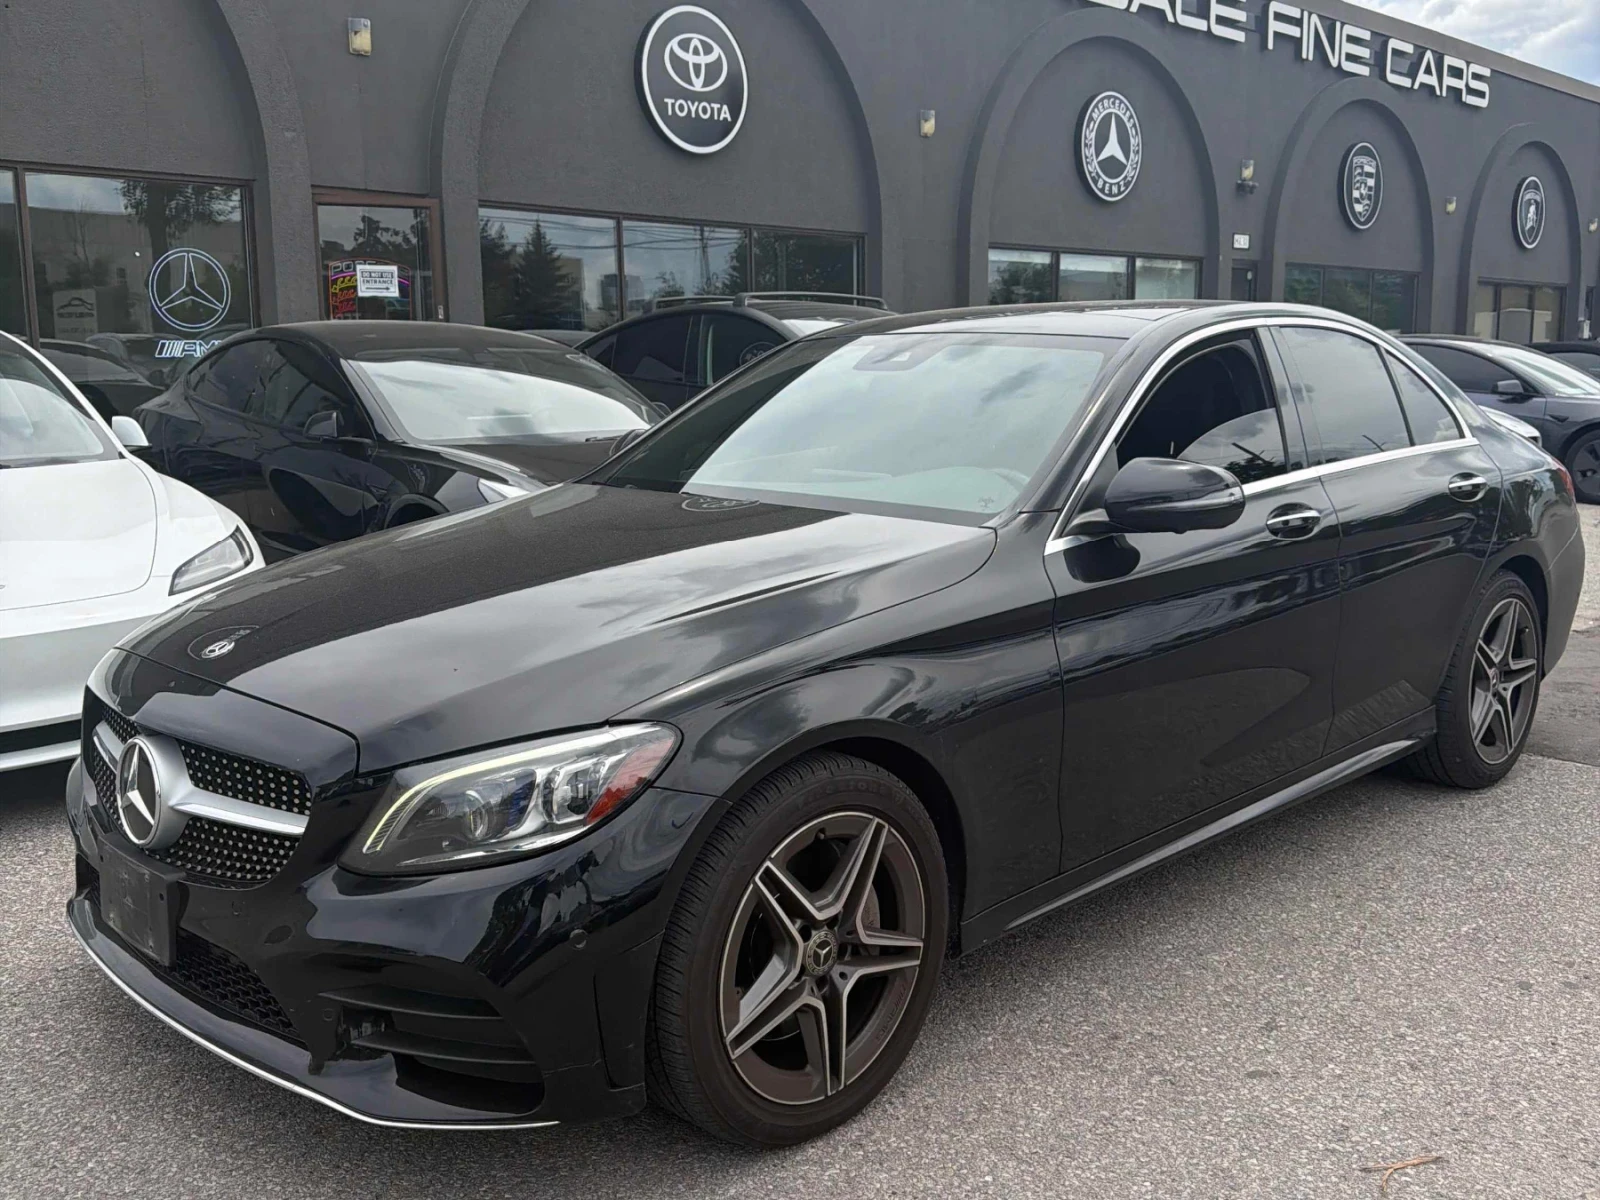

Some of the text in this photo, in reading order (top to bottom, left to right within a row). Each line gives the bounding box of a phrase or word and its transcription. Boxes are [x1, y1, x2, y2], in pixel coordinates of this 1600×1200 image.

[1087, 0, 1491, 108] LE FINE CARS
[664, 98, 732, 122] TOYOTA
[1091, 98, 1134, 127] MERCEDES
[1097, 180, 1126, 195] BENZ
